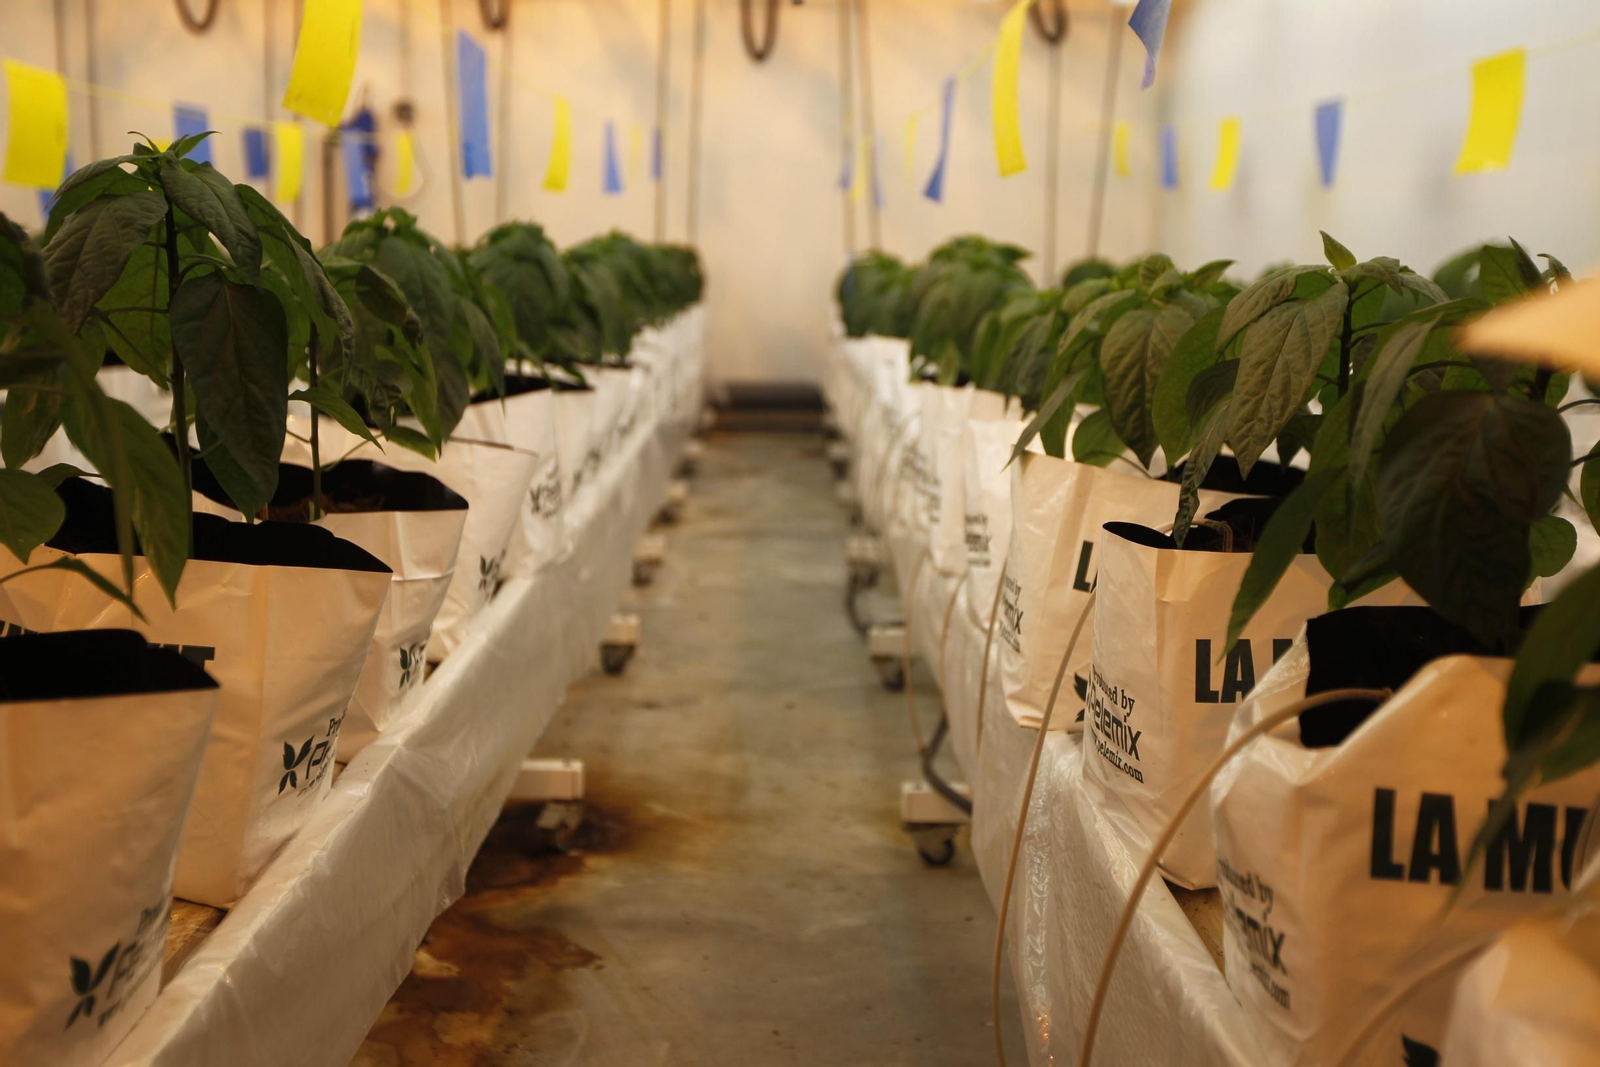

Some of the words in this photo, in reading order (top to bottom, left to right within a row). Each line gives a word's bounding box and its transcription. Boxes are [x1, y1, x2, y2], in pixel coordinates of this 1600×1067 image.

[1073, 540, 1098, 593] L
[1195, 638, 1256, 703] LA
[1121, 689, 1136, 717] by
[1370, 787, 1461, 886] LA
